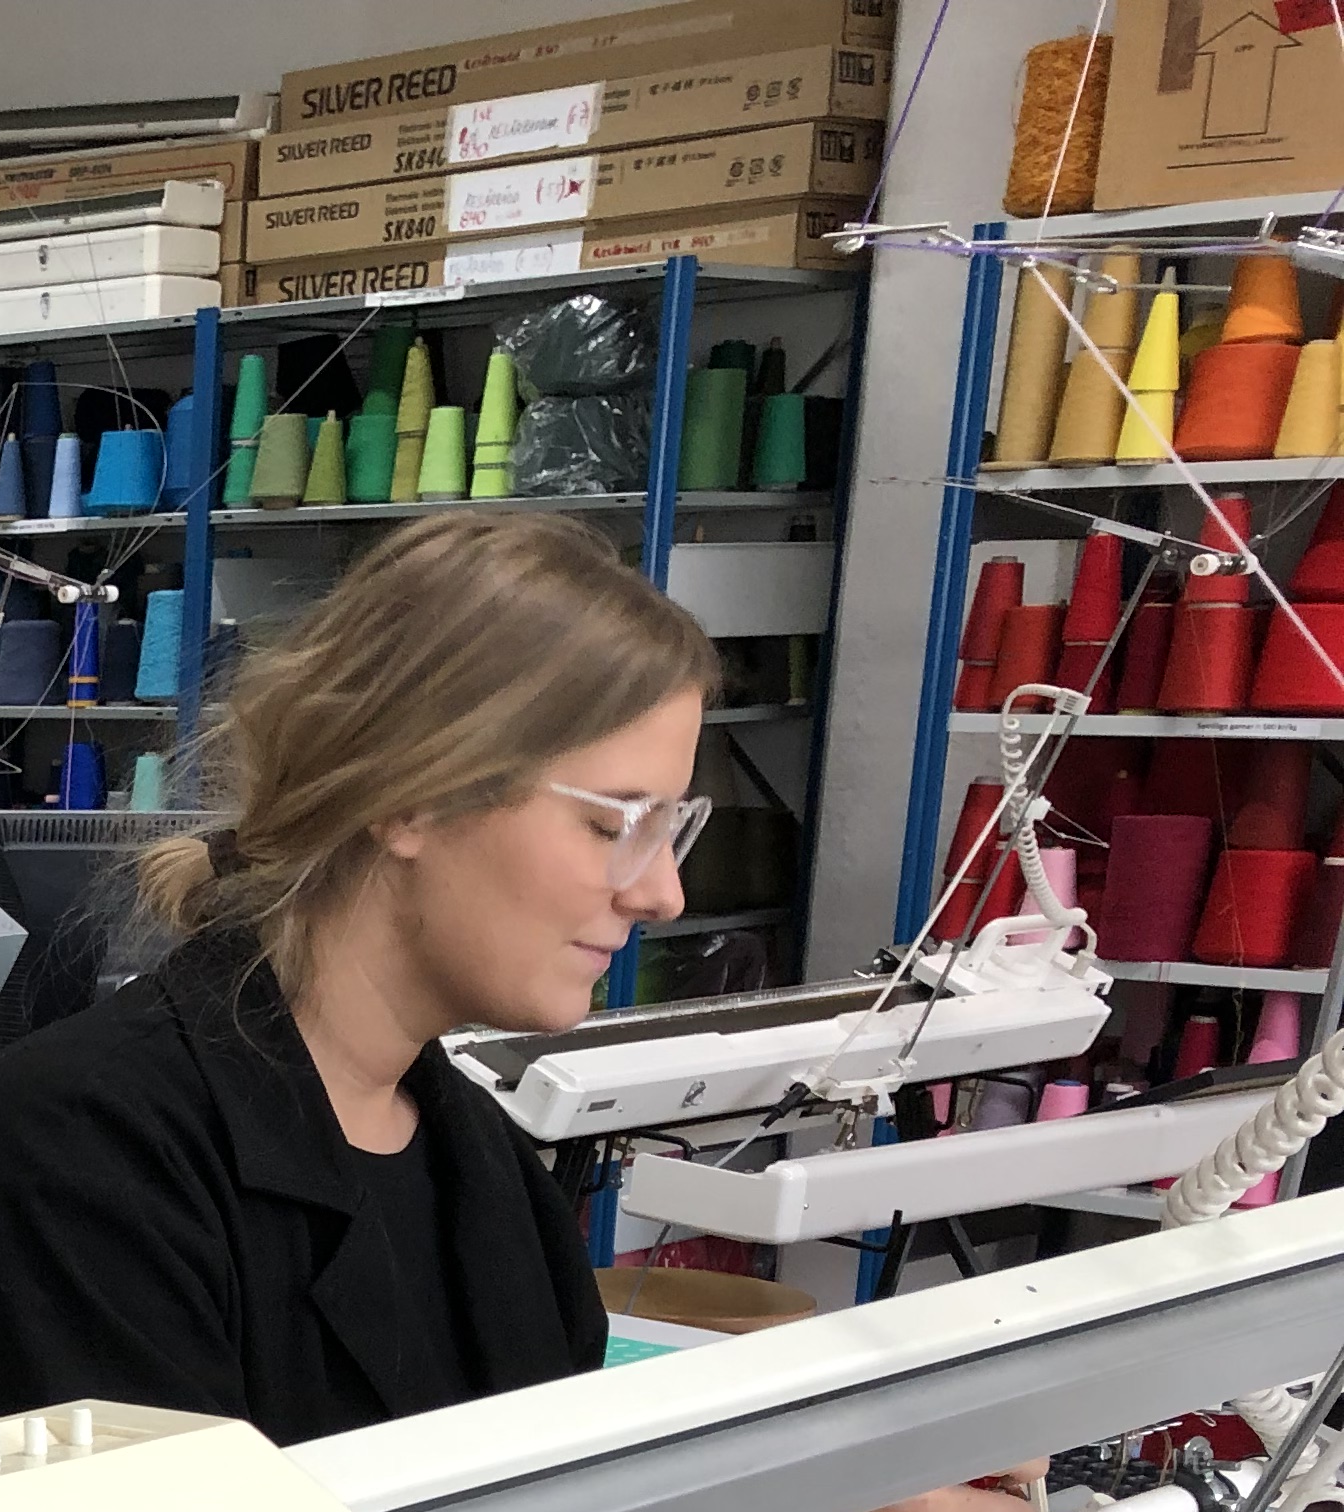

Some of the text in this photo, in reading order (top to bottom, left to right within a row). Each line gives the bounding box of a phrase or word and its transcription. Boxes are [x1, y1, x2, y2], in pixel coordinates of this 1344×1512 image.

[301, 64, 457, 119] SILVER REED
[277, 139, 327, 163] SILVER
[329, 133, 372, 154] REED
[265, 206, 317, 230] SILVER
[317, 201, 360, 222] REED
[382, 215, 436, 243] SK840
[277, 268, 357, 303] SILVER
[362, 260, 429, 295] REED
